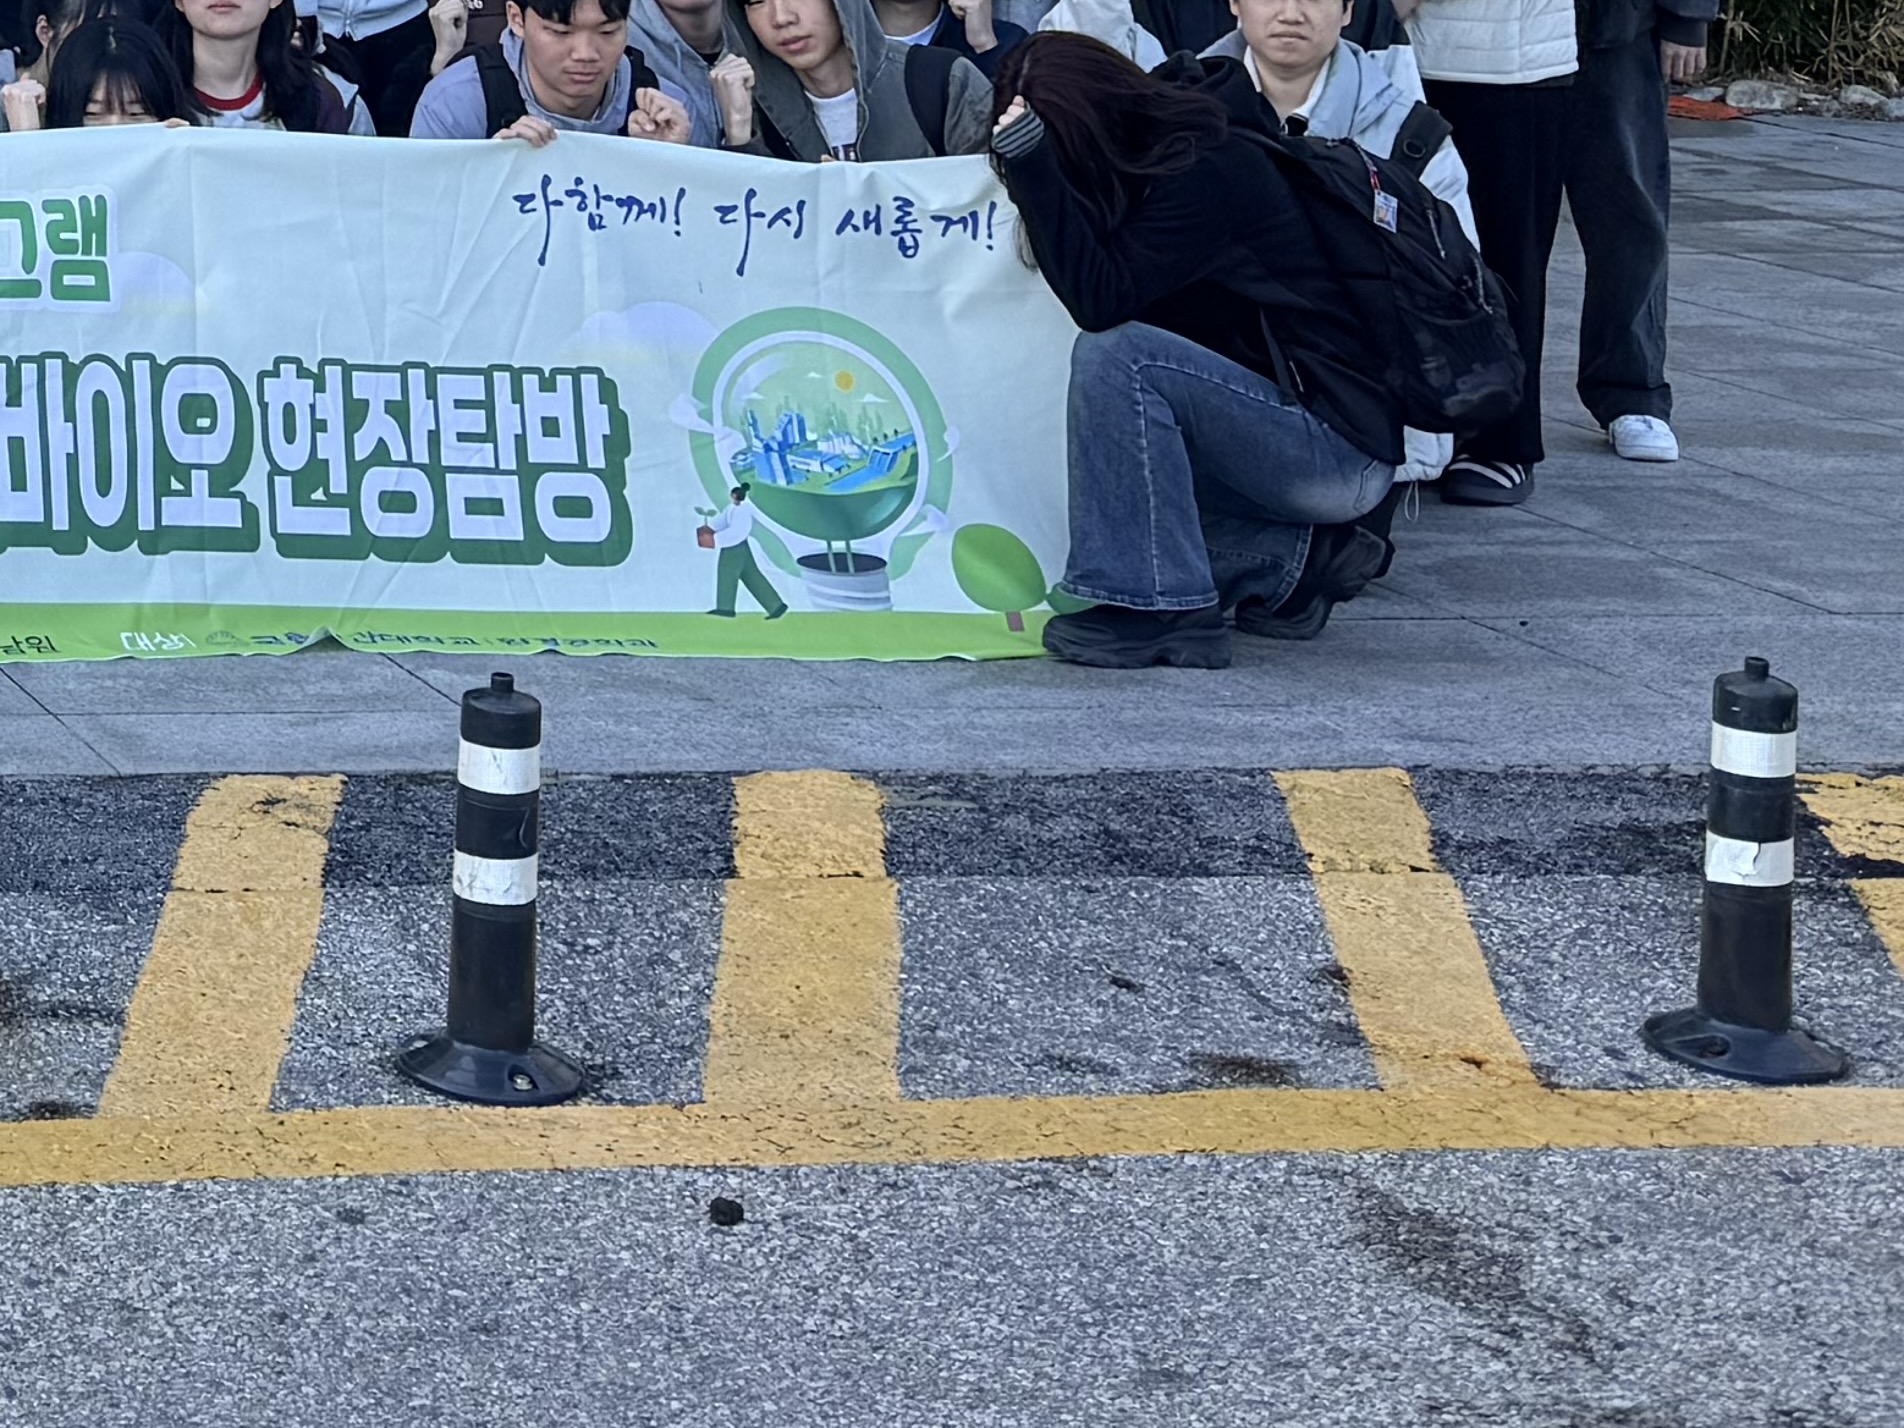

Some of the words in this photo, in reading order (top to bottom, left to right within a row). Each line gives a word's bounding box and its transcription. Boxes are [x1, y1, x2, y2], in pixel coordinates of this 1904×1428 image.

[512, 173, 686, 267] 다함께!
[713, 188, 807, 276] 다시
[835, 196, 998, 259] 새롭게!
[259, 357, 624, 559] 현장탐방
